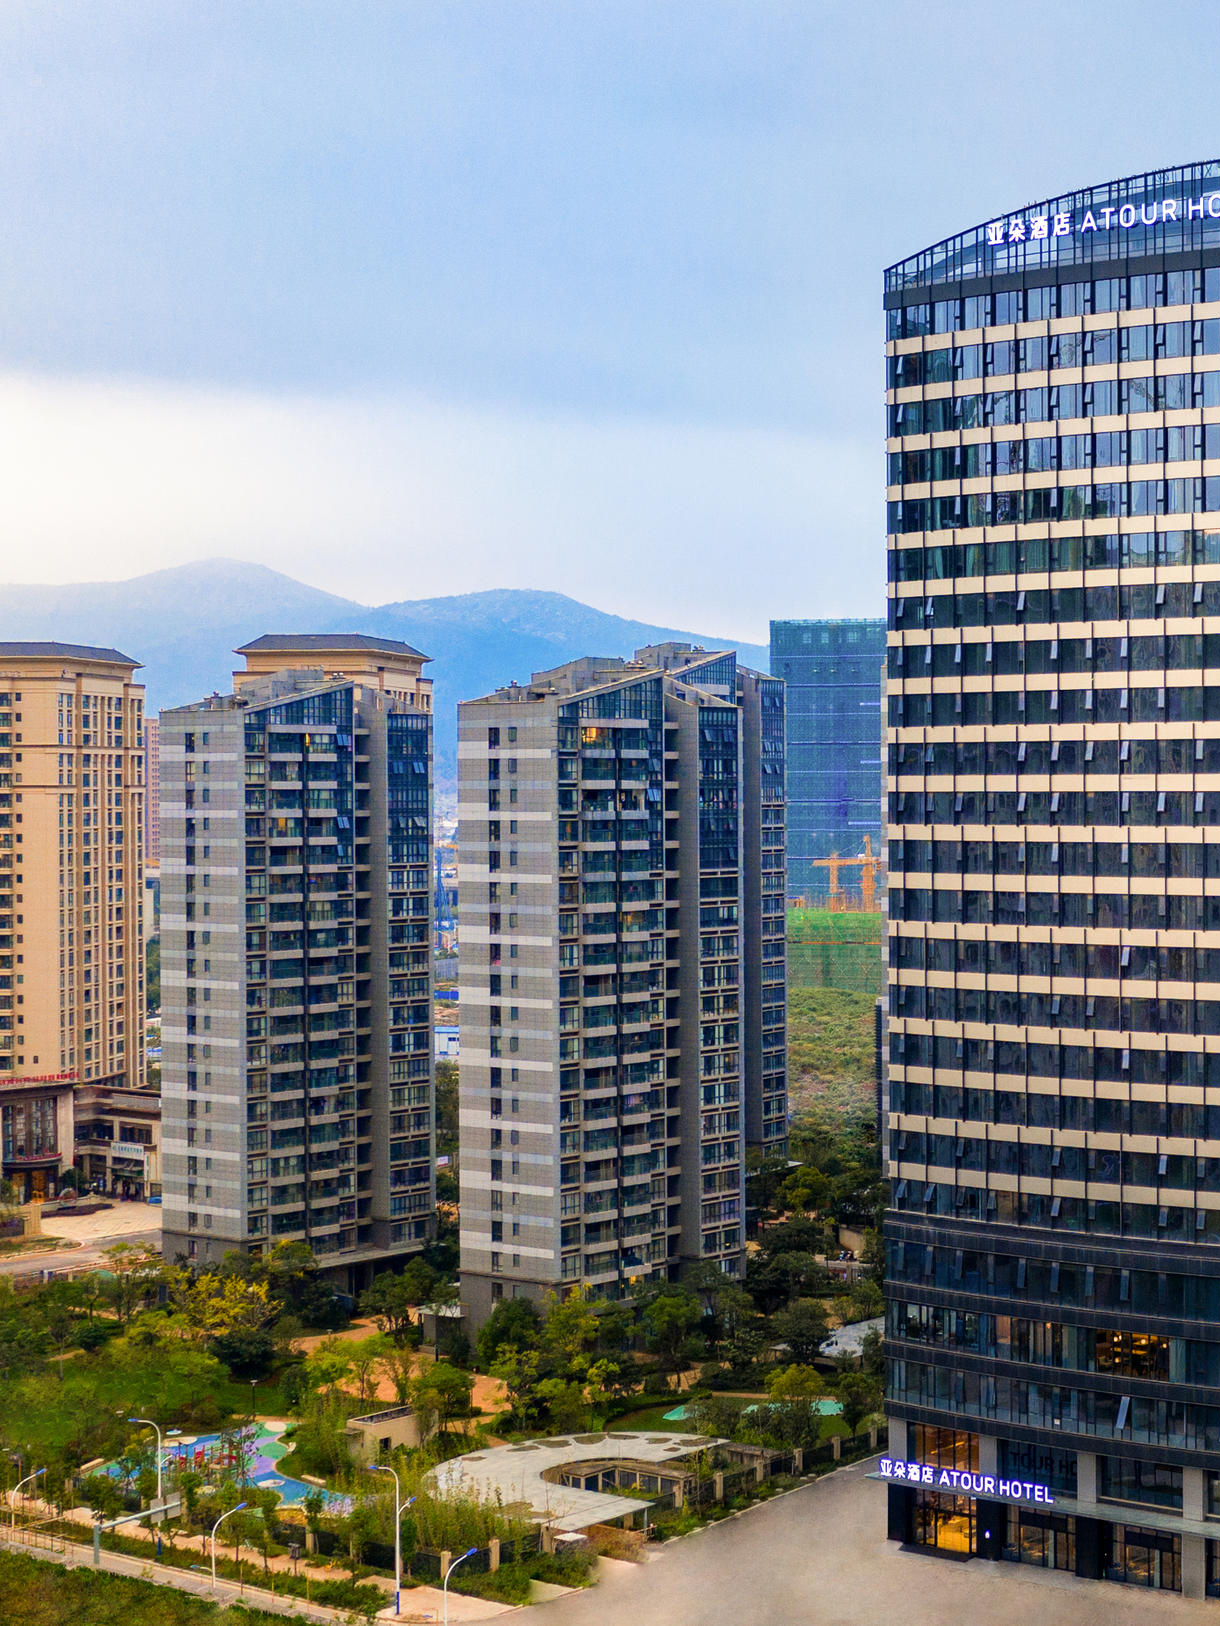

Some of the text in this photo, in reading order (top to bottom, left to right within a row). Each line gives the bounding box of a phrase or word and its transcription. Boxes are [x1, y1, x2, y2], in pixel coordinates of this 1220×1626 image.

[986, 212, 1072, 246] 亚朵酒店
[1080, 198, 1177, 233] ATOUR
[880, 1458, 1054, 1504] 亚朵酒店 ATOUR HOTEL
